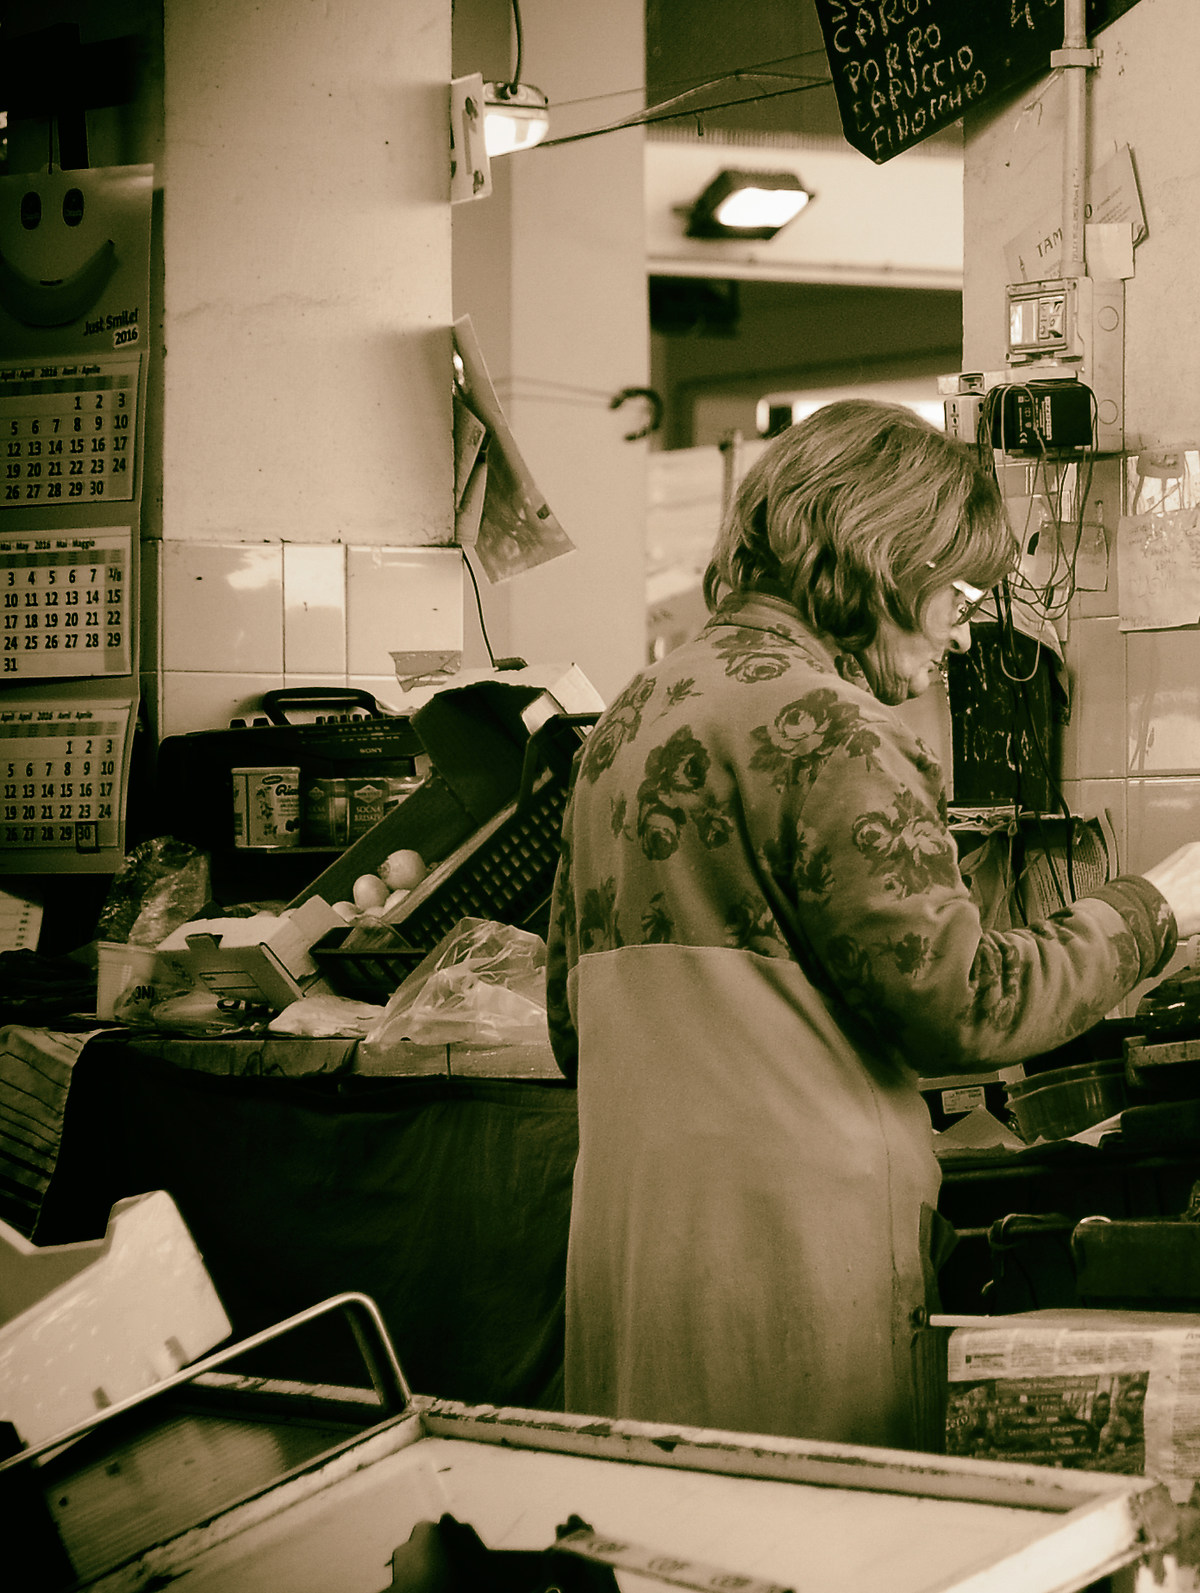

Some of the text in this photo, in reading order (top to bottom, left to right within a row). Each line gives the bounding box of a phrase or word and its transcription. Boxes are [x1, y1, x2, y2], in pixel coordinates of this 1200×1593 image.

[843, 22, 942, 94] PORRO
[853, 45, 974, 132] CAPUCCIO
[83, 307, 138, 337] Just Smile!
[115, 327, 138, 345] 2016
[75, 393, 125, 410] 1 2 3
[11, 415, 128, 435] 5 6 7 8 9 10
[7, 436, 127, 457] 12 13 14 15 16 17
[6, 458, 126, 478] 19 20 21 22 23 24
[5, 481, 103, 500] 26 27 28 29 30
[8, 568, 121, 586] 3 4 5 6 7 1/8
[5, 589, 121, 607] 10 11 12 13 14 15
[5, 611, 120, 629] 17 18 19 20 21 22
[4, 633, 121, 650] 24 25 26 27 28 29
[4, 658, 17, 672] 31
[66, 739, 112, 754] 1 2 3
[8, 761, 114, 777] 5 6 7 8 9 10
[5, 782, 112, 799] 12 13 14 15 16 17
[5, 804, 111, 820] 19 20 21 22 23 24
[6, 826, 90, 841] 26 27 28 29 30
